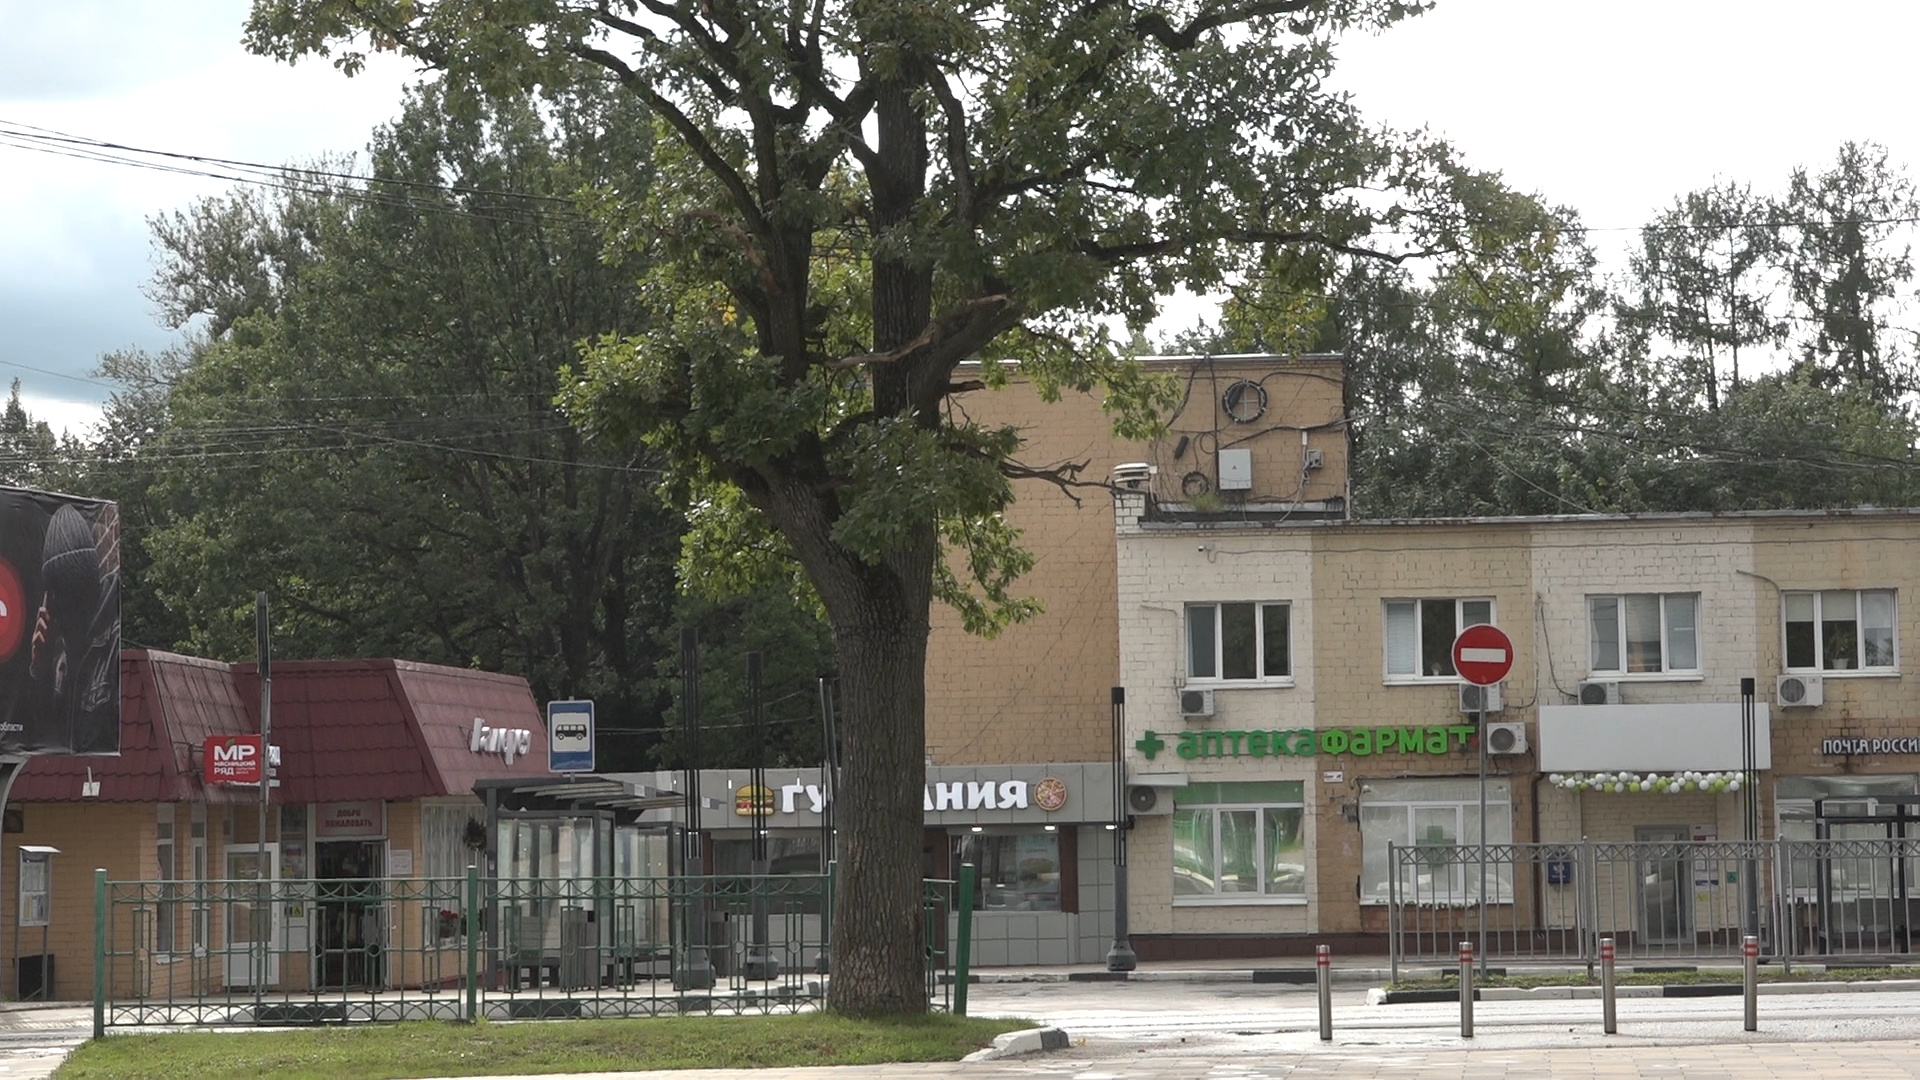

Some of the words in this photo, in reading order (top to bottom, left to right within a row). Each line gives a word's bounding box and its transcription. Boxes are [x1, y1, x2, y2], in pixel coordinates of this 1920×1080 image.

[1823, 738, 1869, 755] ПОЧТА
[1872, 738, 1920, 755] РОССИ
[214, 745, 255, 761] МР
[214, 767, 234, 776] РЯД
[337, 809, 361, 818] ДОБРО
[325, 819, 373, 828] ПОЖАЛОВАТЬ
